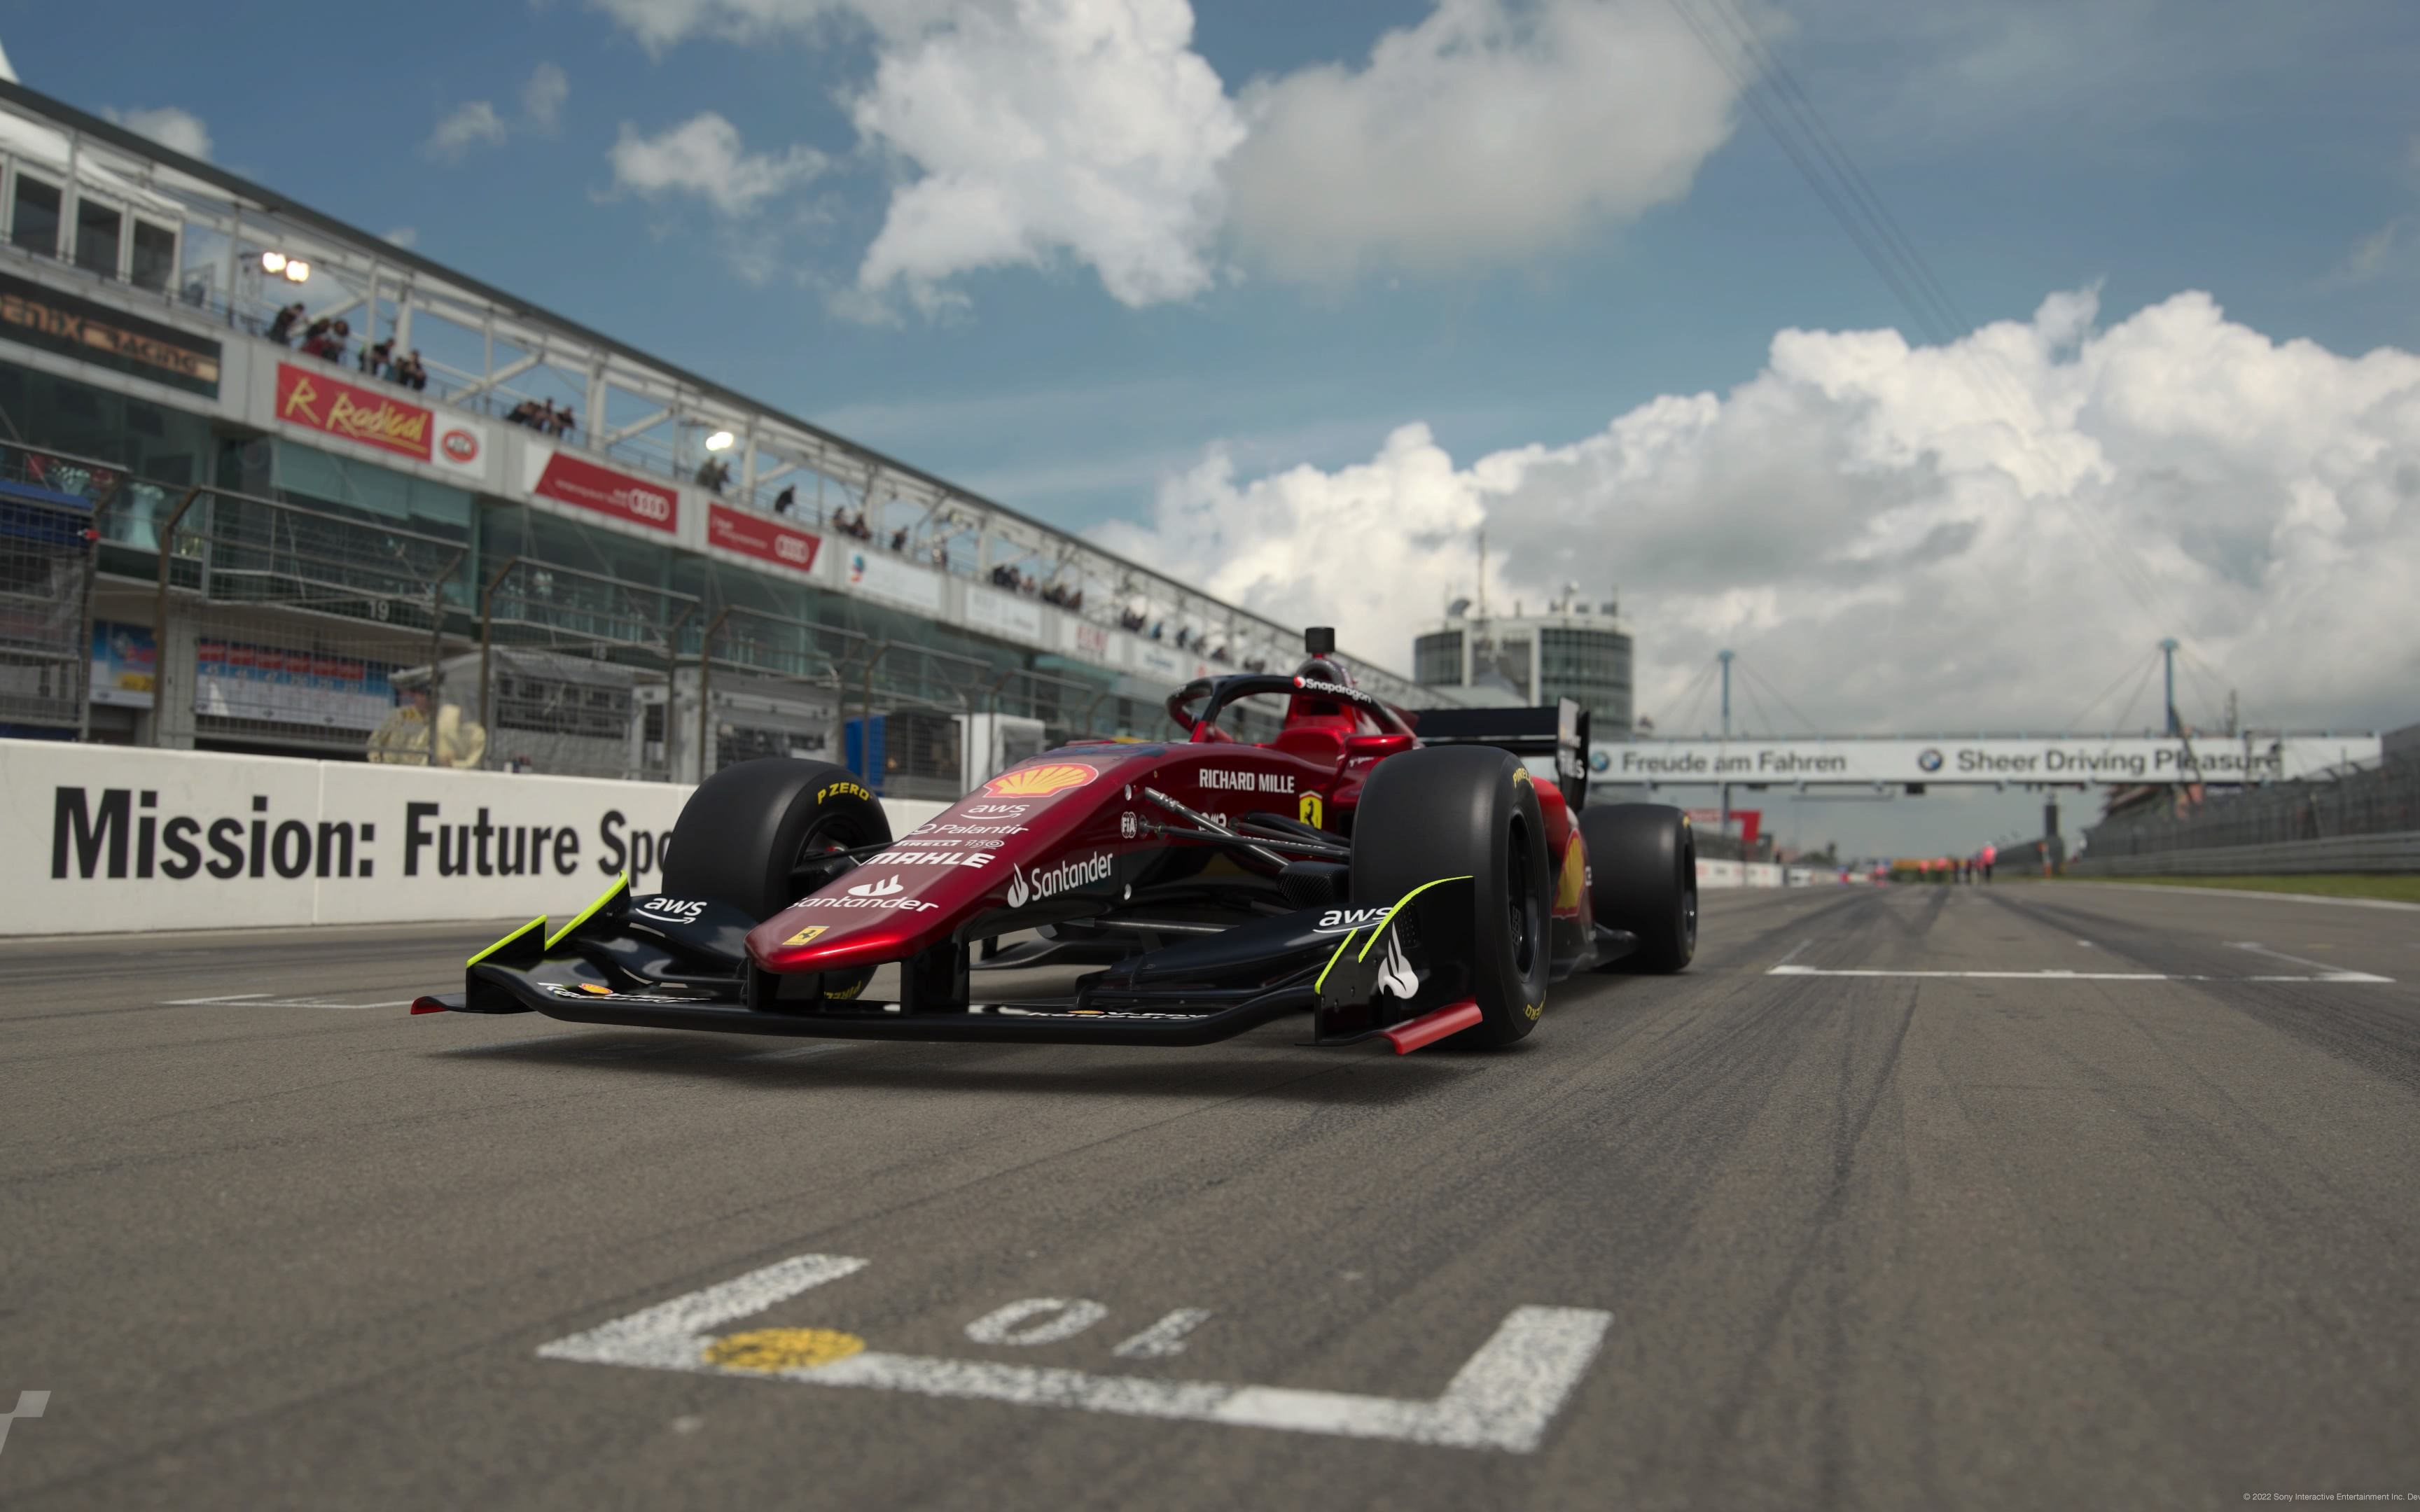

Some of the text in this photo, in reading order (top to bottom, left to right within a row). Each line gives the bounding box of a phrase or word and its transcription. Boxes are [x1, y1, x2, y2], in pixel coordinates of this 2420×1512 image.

[326, 392, 428, 444] Radical
[1305, 678, 1372, 704] Snapdragon
[1622, 751, 1846, 771] Freude am Fahren
[1959, 749, 2283, 776] Sheer Driving Pleasure
[817, 781, 870, 806] P ZERO
[1199, 768, 1295, 794] RICHARD MILLE
[968, 804, 1030, 815] aws
[52, 786, 375, 879] Mission:
[404, 802, 580, 876] Future
[933, 824, 1029, 834] Palantir
[859, 852, 996, 869] MAHLE
[1031, 850, 1113, 902] Santander
[644, 897, 708, 918] aws
[1318, 906, 1393, 927] aws
